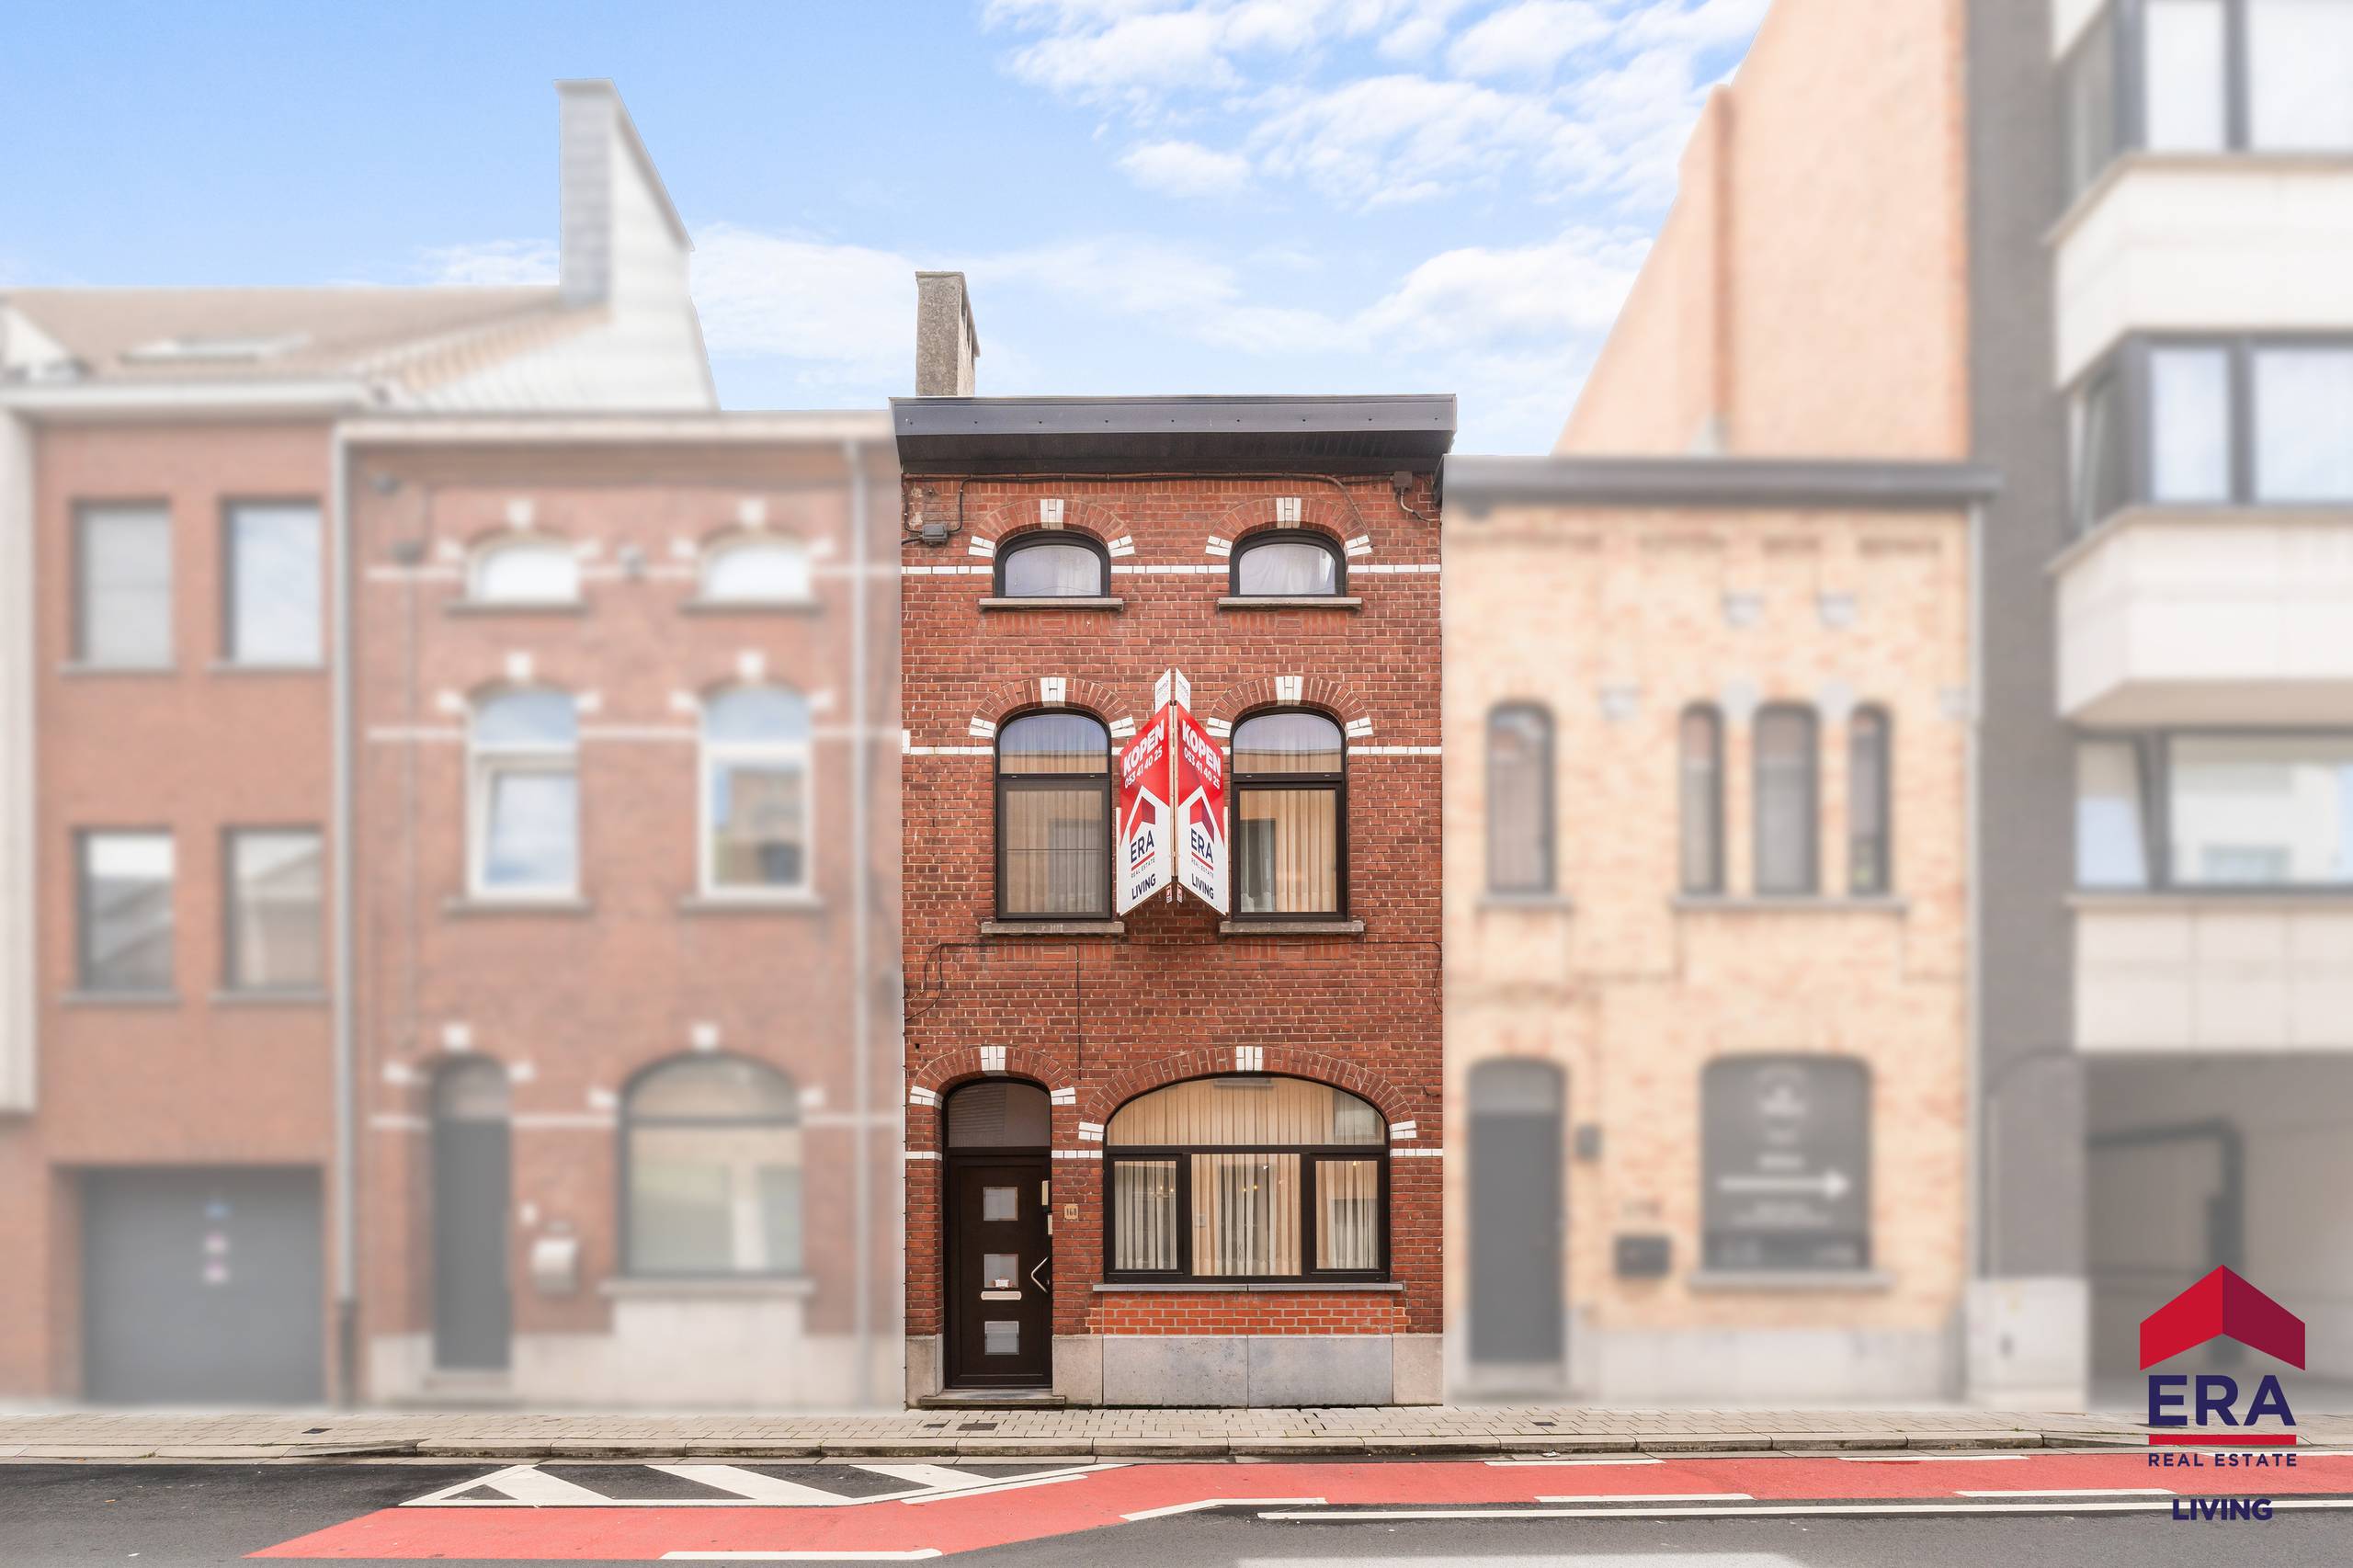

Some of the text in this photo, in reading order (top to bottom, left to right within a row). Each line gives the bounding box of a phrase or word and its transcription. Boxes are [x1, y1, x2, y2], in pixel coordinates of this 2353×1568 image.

[1123, 719, 1165, 778] KOPEN
[1182, 719, 1222, 778] KOPEN
[1125, 745, 1163, 789] 053 41 40 25
[1184, 746, 1221, 790] 053 41 40 25
[1131, 830, 1154, 864] ERA
[1142, 857, 1155, 871] ESTATE
[1190, 828, 1214, 864] ERA
[1131, 873, 1156, 900] LIVING
[1191, 873, 1214, 900] LIVING
